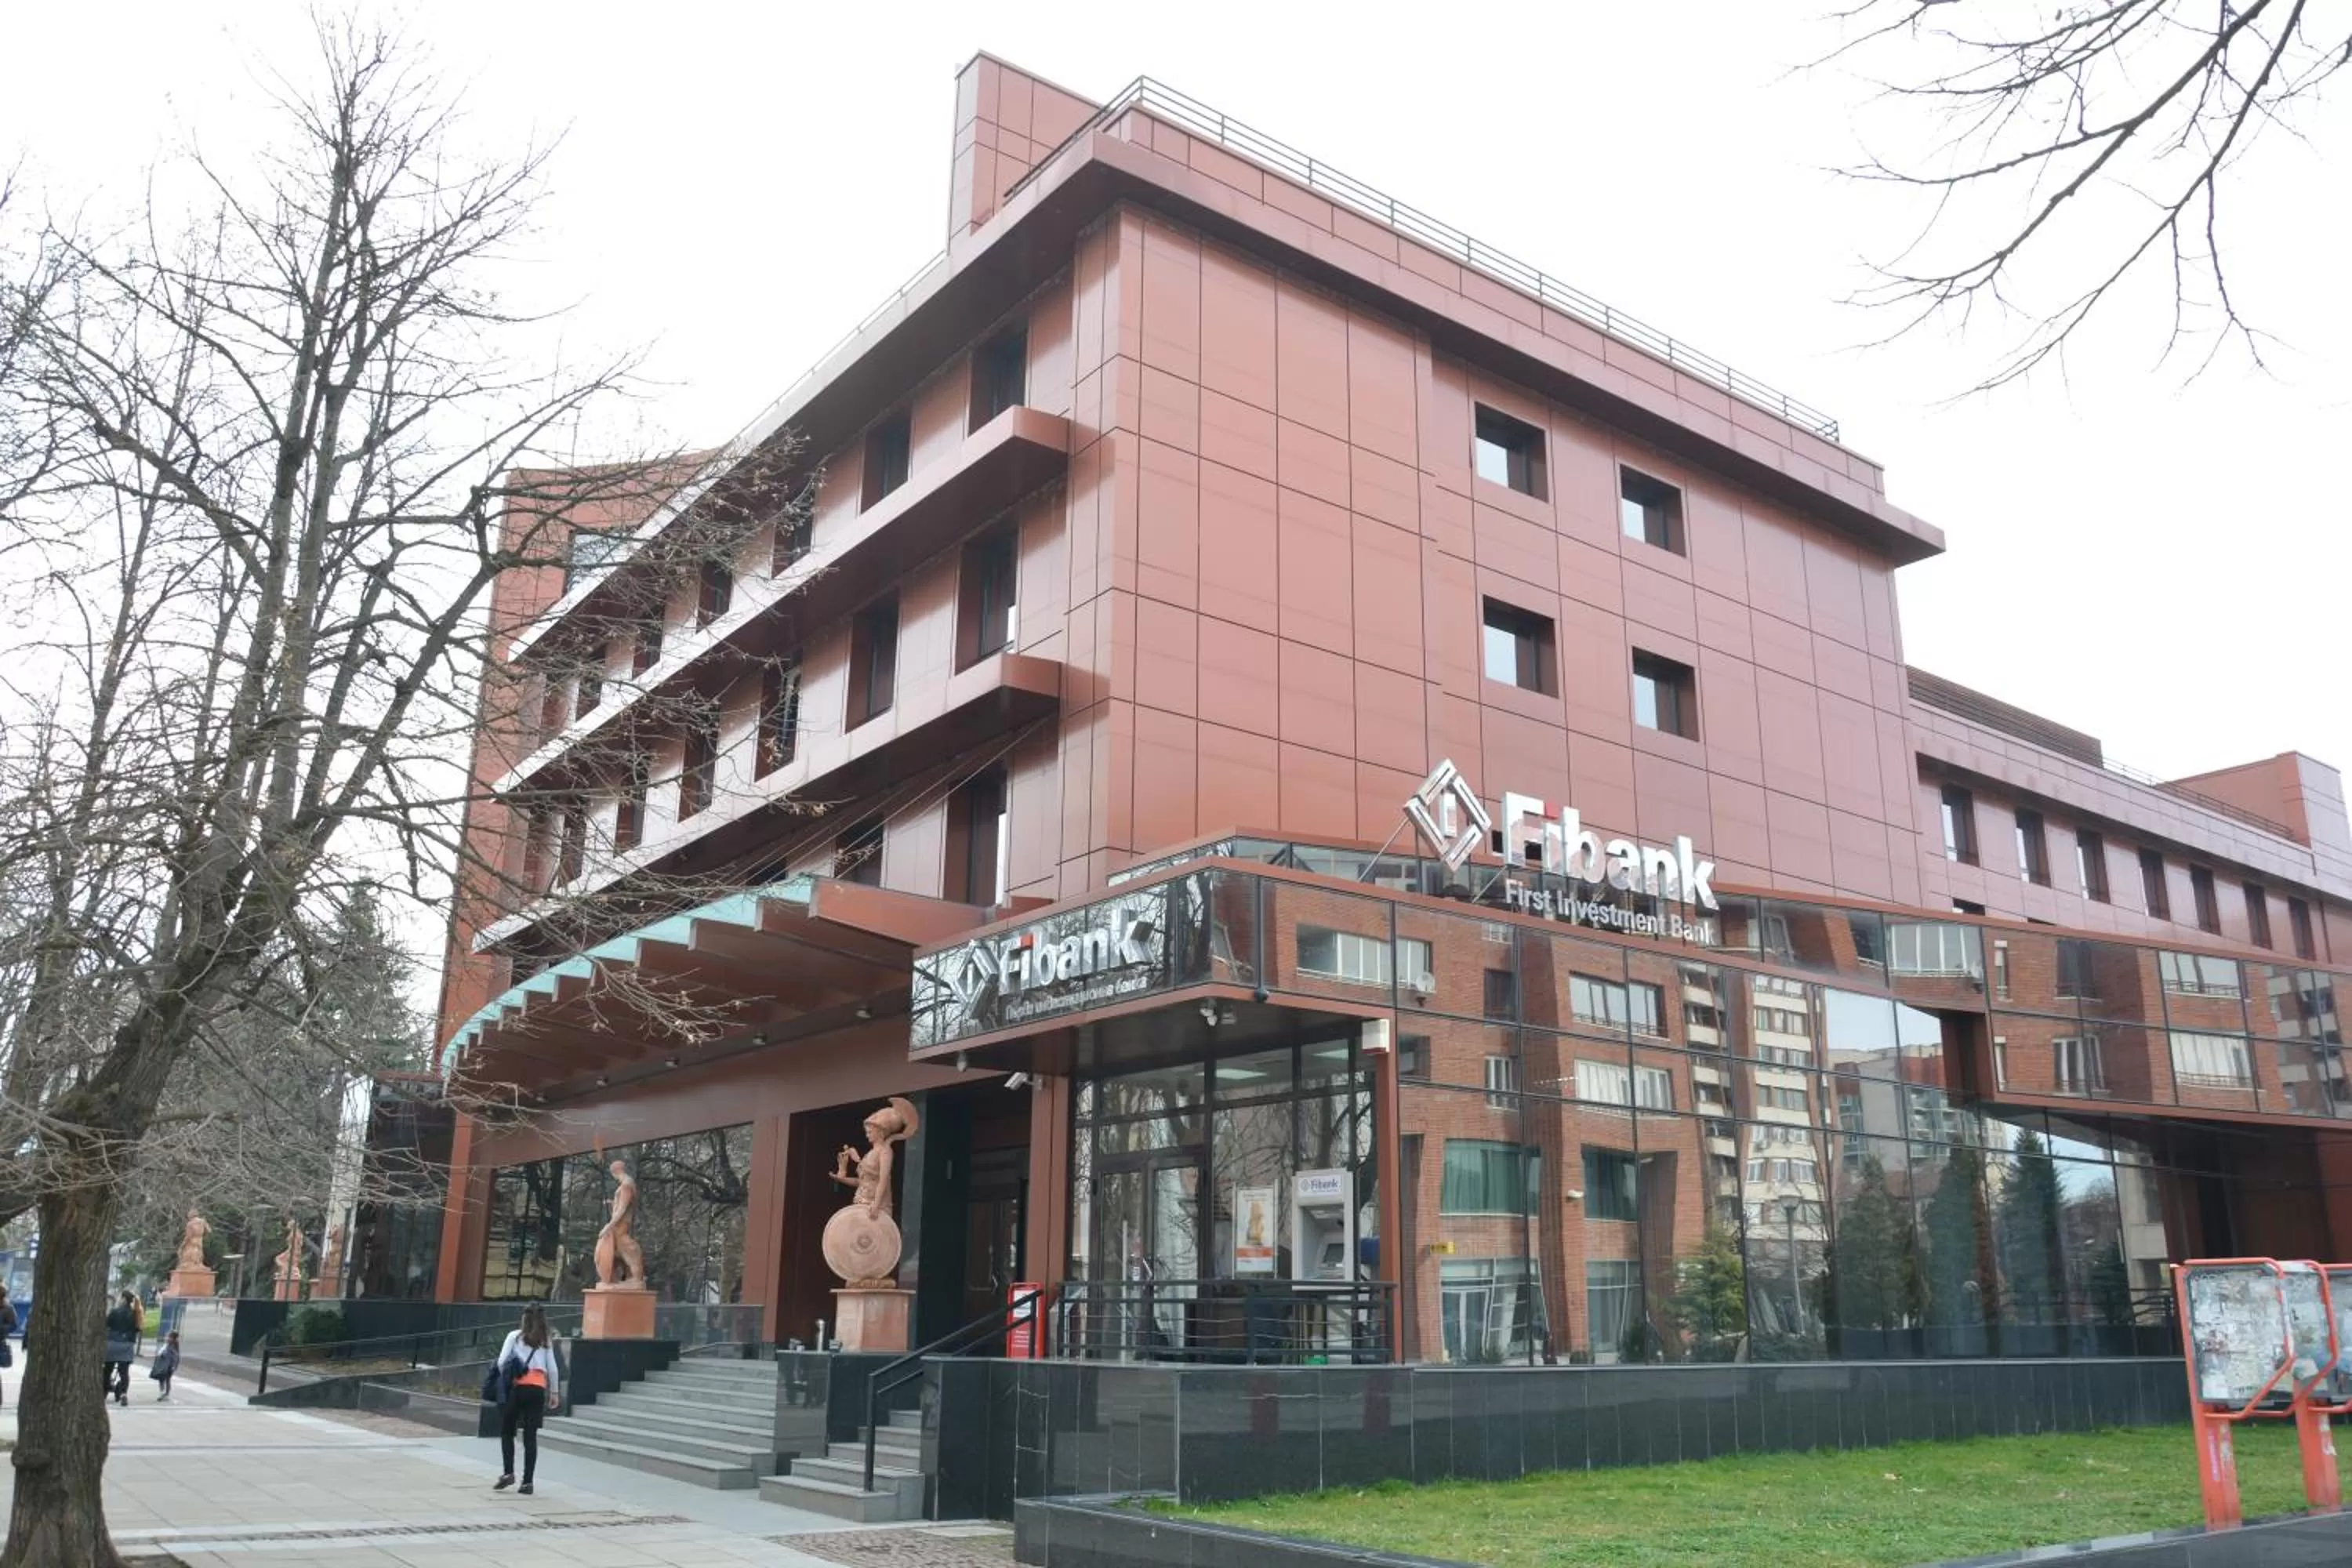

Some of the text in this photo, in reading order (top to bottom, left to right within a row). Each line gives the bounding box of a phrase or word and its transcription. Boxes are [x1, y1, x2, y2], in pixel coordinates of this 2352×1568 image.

[1501, 791, 1719, 910] Fibank
[999, 906, 1155, 996] Fibank
[1504, 877, 1715, 946] First Investment Bank
